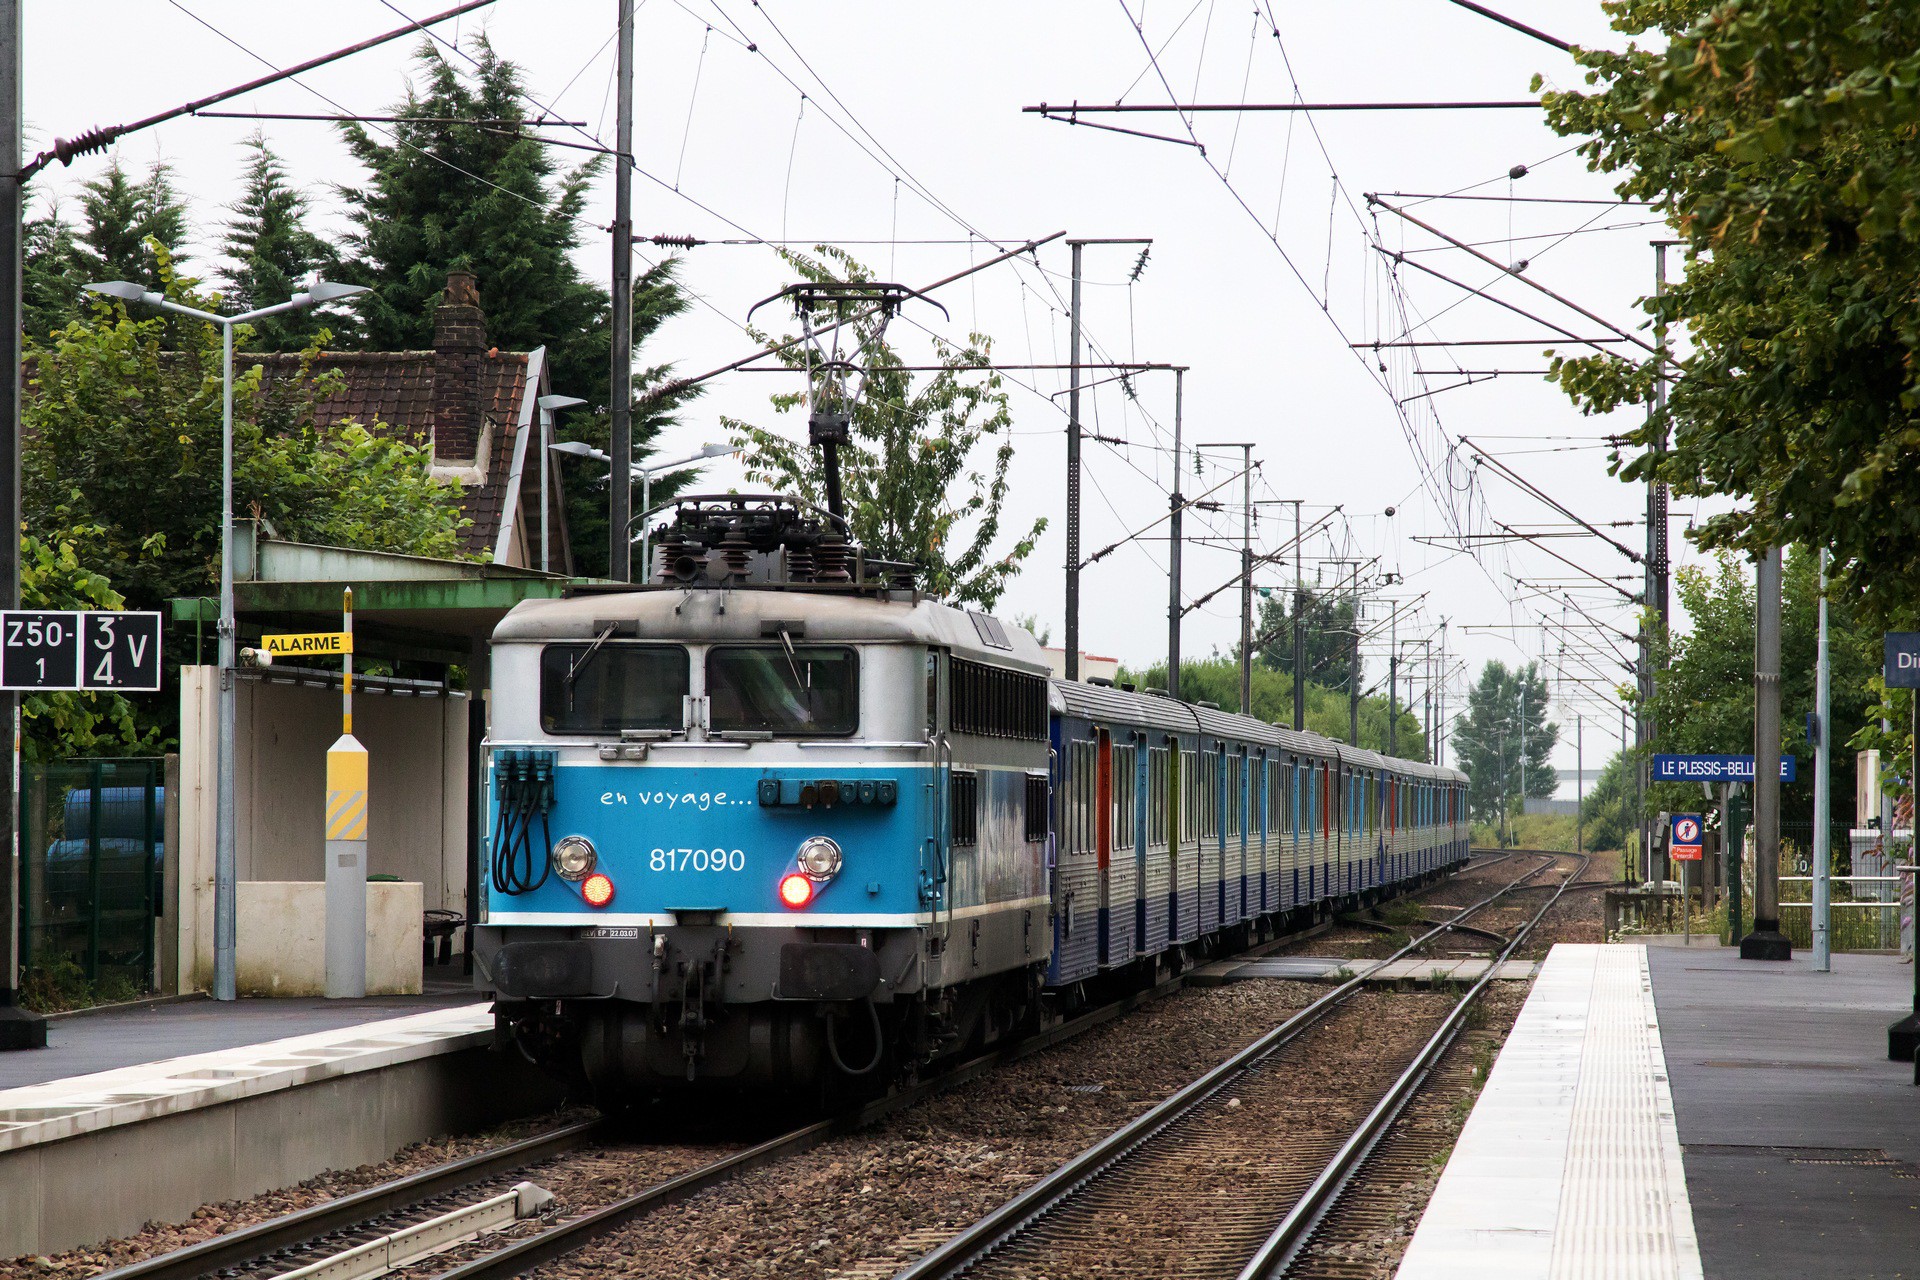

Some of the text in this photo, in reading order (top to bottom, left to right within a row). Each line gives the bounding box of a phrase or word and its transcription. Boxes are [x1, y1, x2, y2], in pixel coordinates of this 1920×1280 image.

[7, 621, 74, 647] Z50-
[94, 616, 115, 650] 3
[268, 636, 341, 652] ALARME
[127, 634, 148, 668] V
[1898, 652, 1920, 668] Di
[35, 657, 45, 679] 1
[93, 651, 115, 685] 4
[1662, 761, 1675, 775] LE
[600, 791, 628, 805] en
[639, 791, 752, 811] voyage...
[649, 848, 746, 872] 817090
[597, 929, 607, 937] EP
